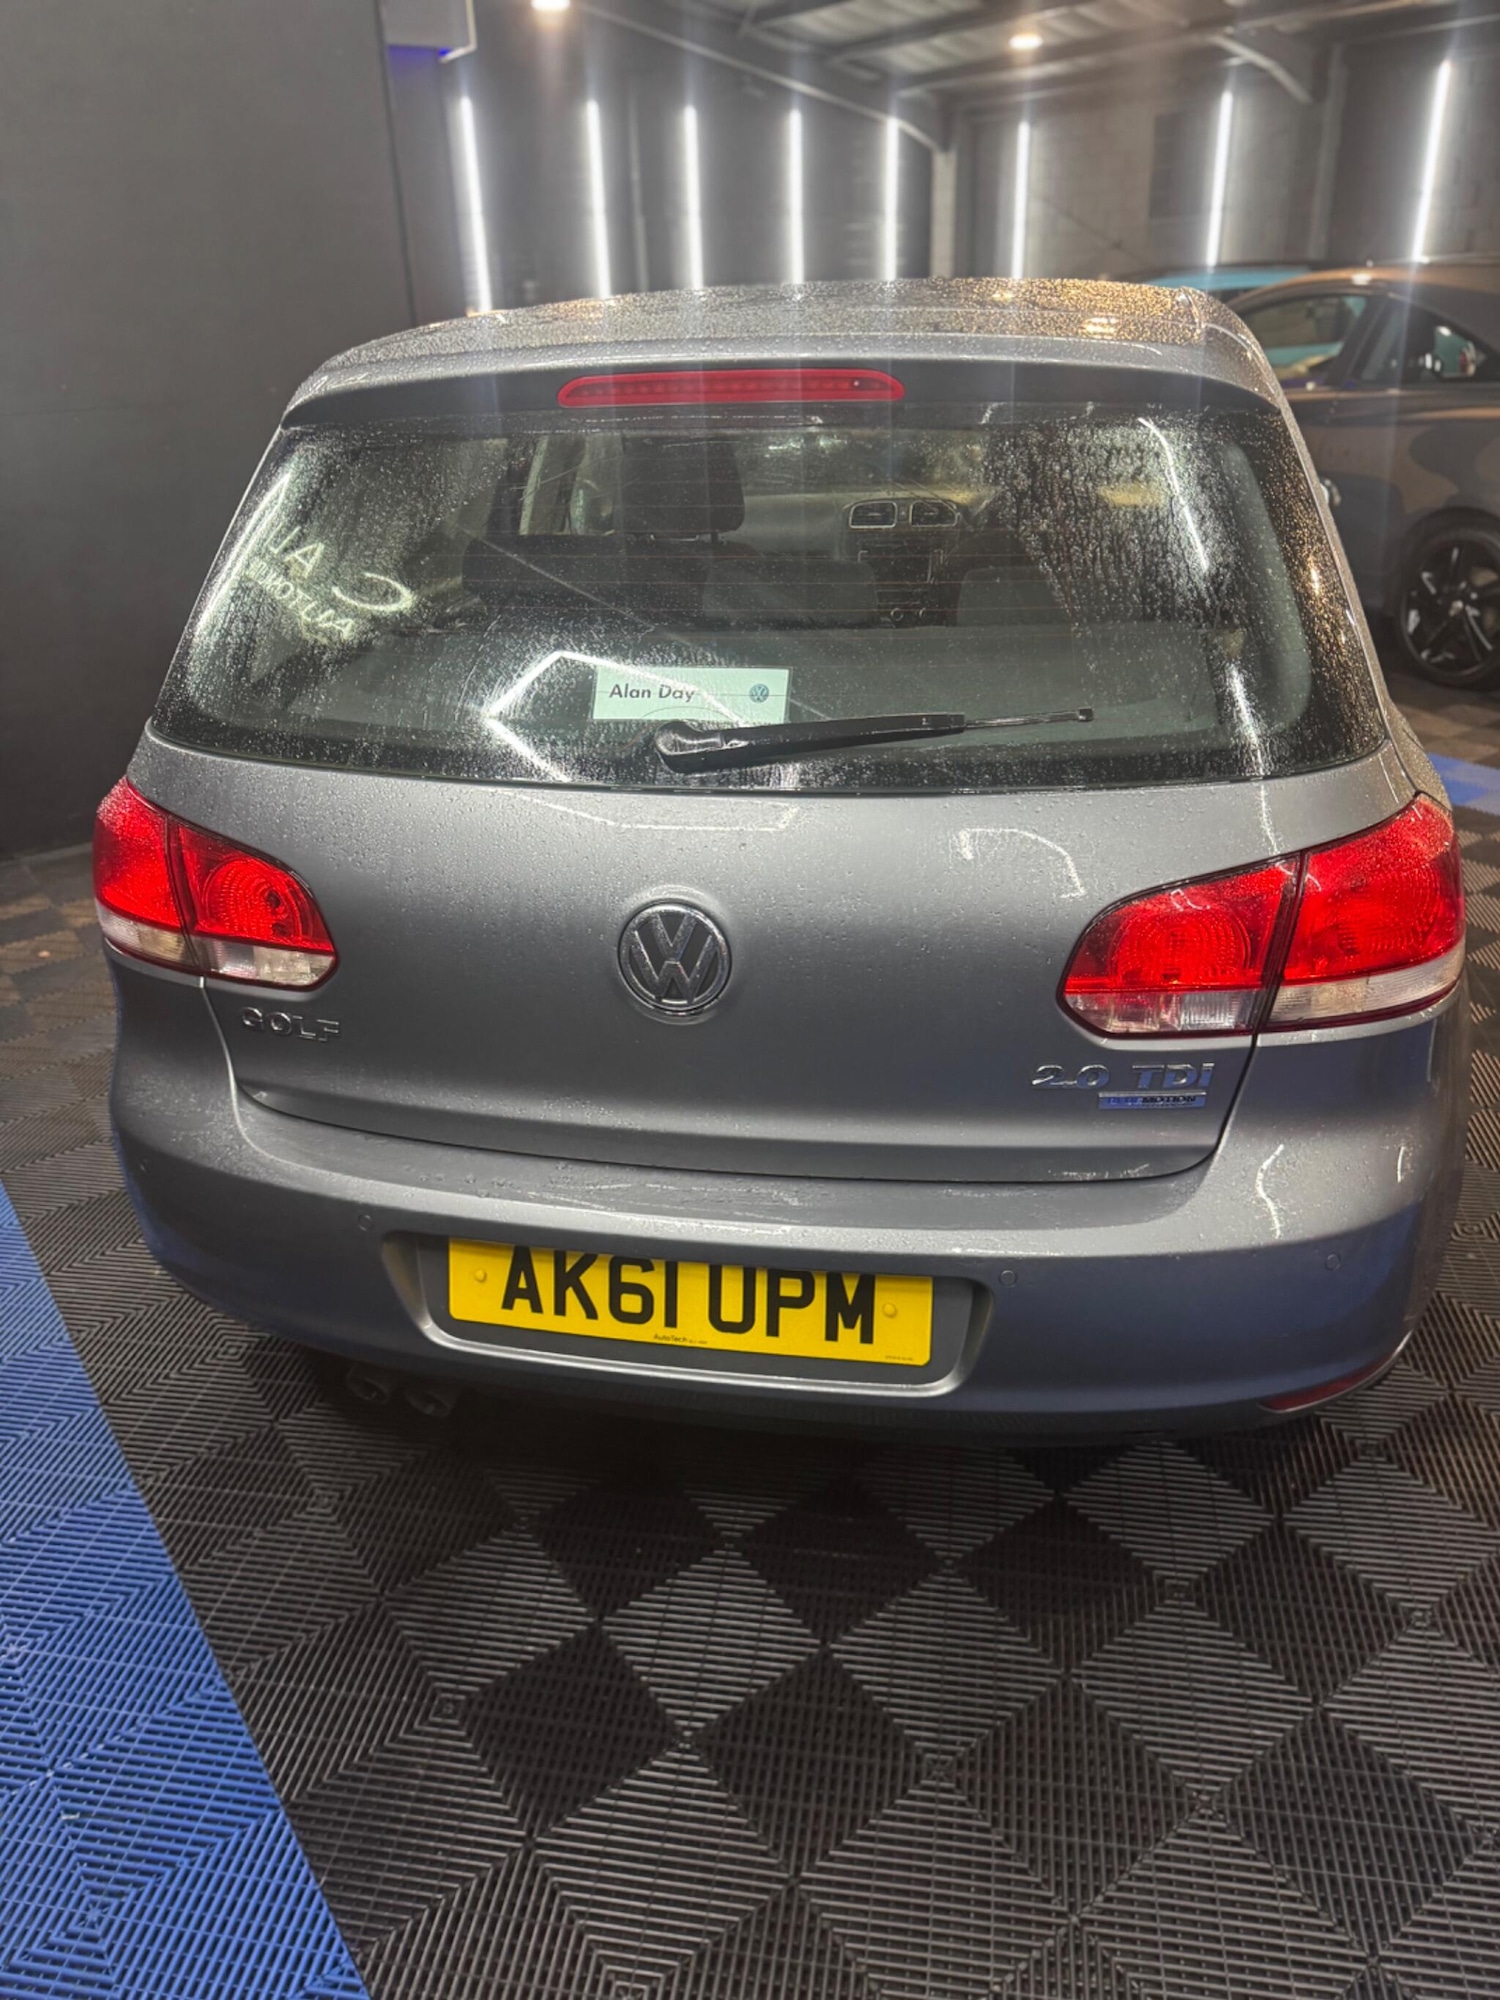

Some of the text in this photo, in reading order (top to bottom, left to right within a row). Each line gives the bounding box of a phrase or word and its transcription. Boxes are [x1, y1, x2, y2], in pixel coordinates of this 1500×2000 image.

[609, 684, 695, 702] Alan Day
[625, 907, 725, 1007] VW
[242, 1007, 339, 1041] GOLF
[1032, 1062, 1214, 1089] 2.0 TDI
[1107, 1095, 1197, 1105] BUEMOTION
[501, 1245, 876, 1344] AK61 UPM
